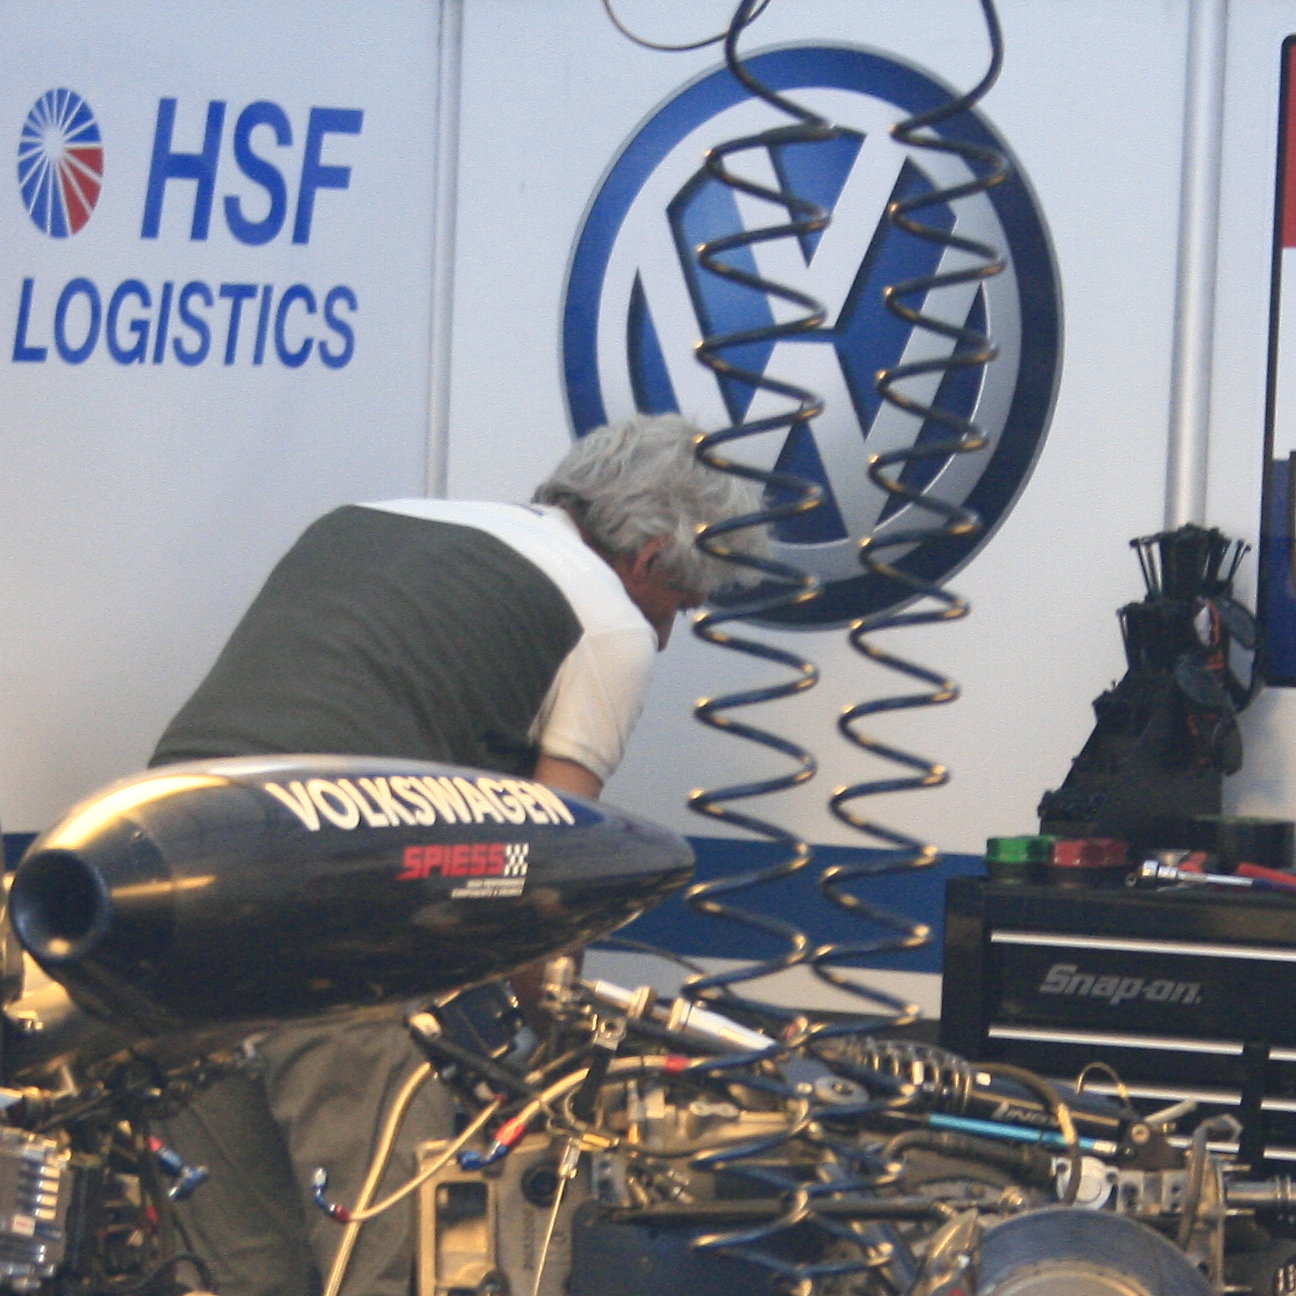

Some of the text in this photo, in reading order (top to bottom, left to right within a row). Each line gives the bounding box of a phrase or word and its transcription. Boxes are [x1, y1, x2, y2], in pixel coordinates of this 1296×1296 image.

[140, 97, 365, 247] HSF
[11, 276, 359, 370] LOGISTICS
[265, 775, 575, 832] VOLKSWAGEN
[396, 842, 505, 881] SPIESS
